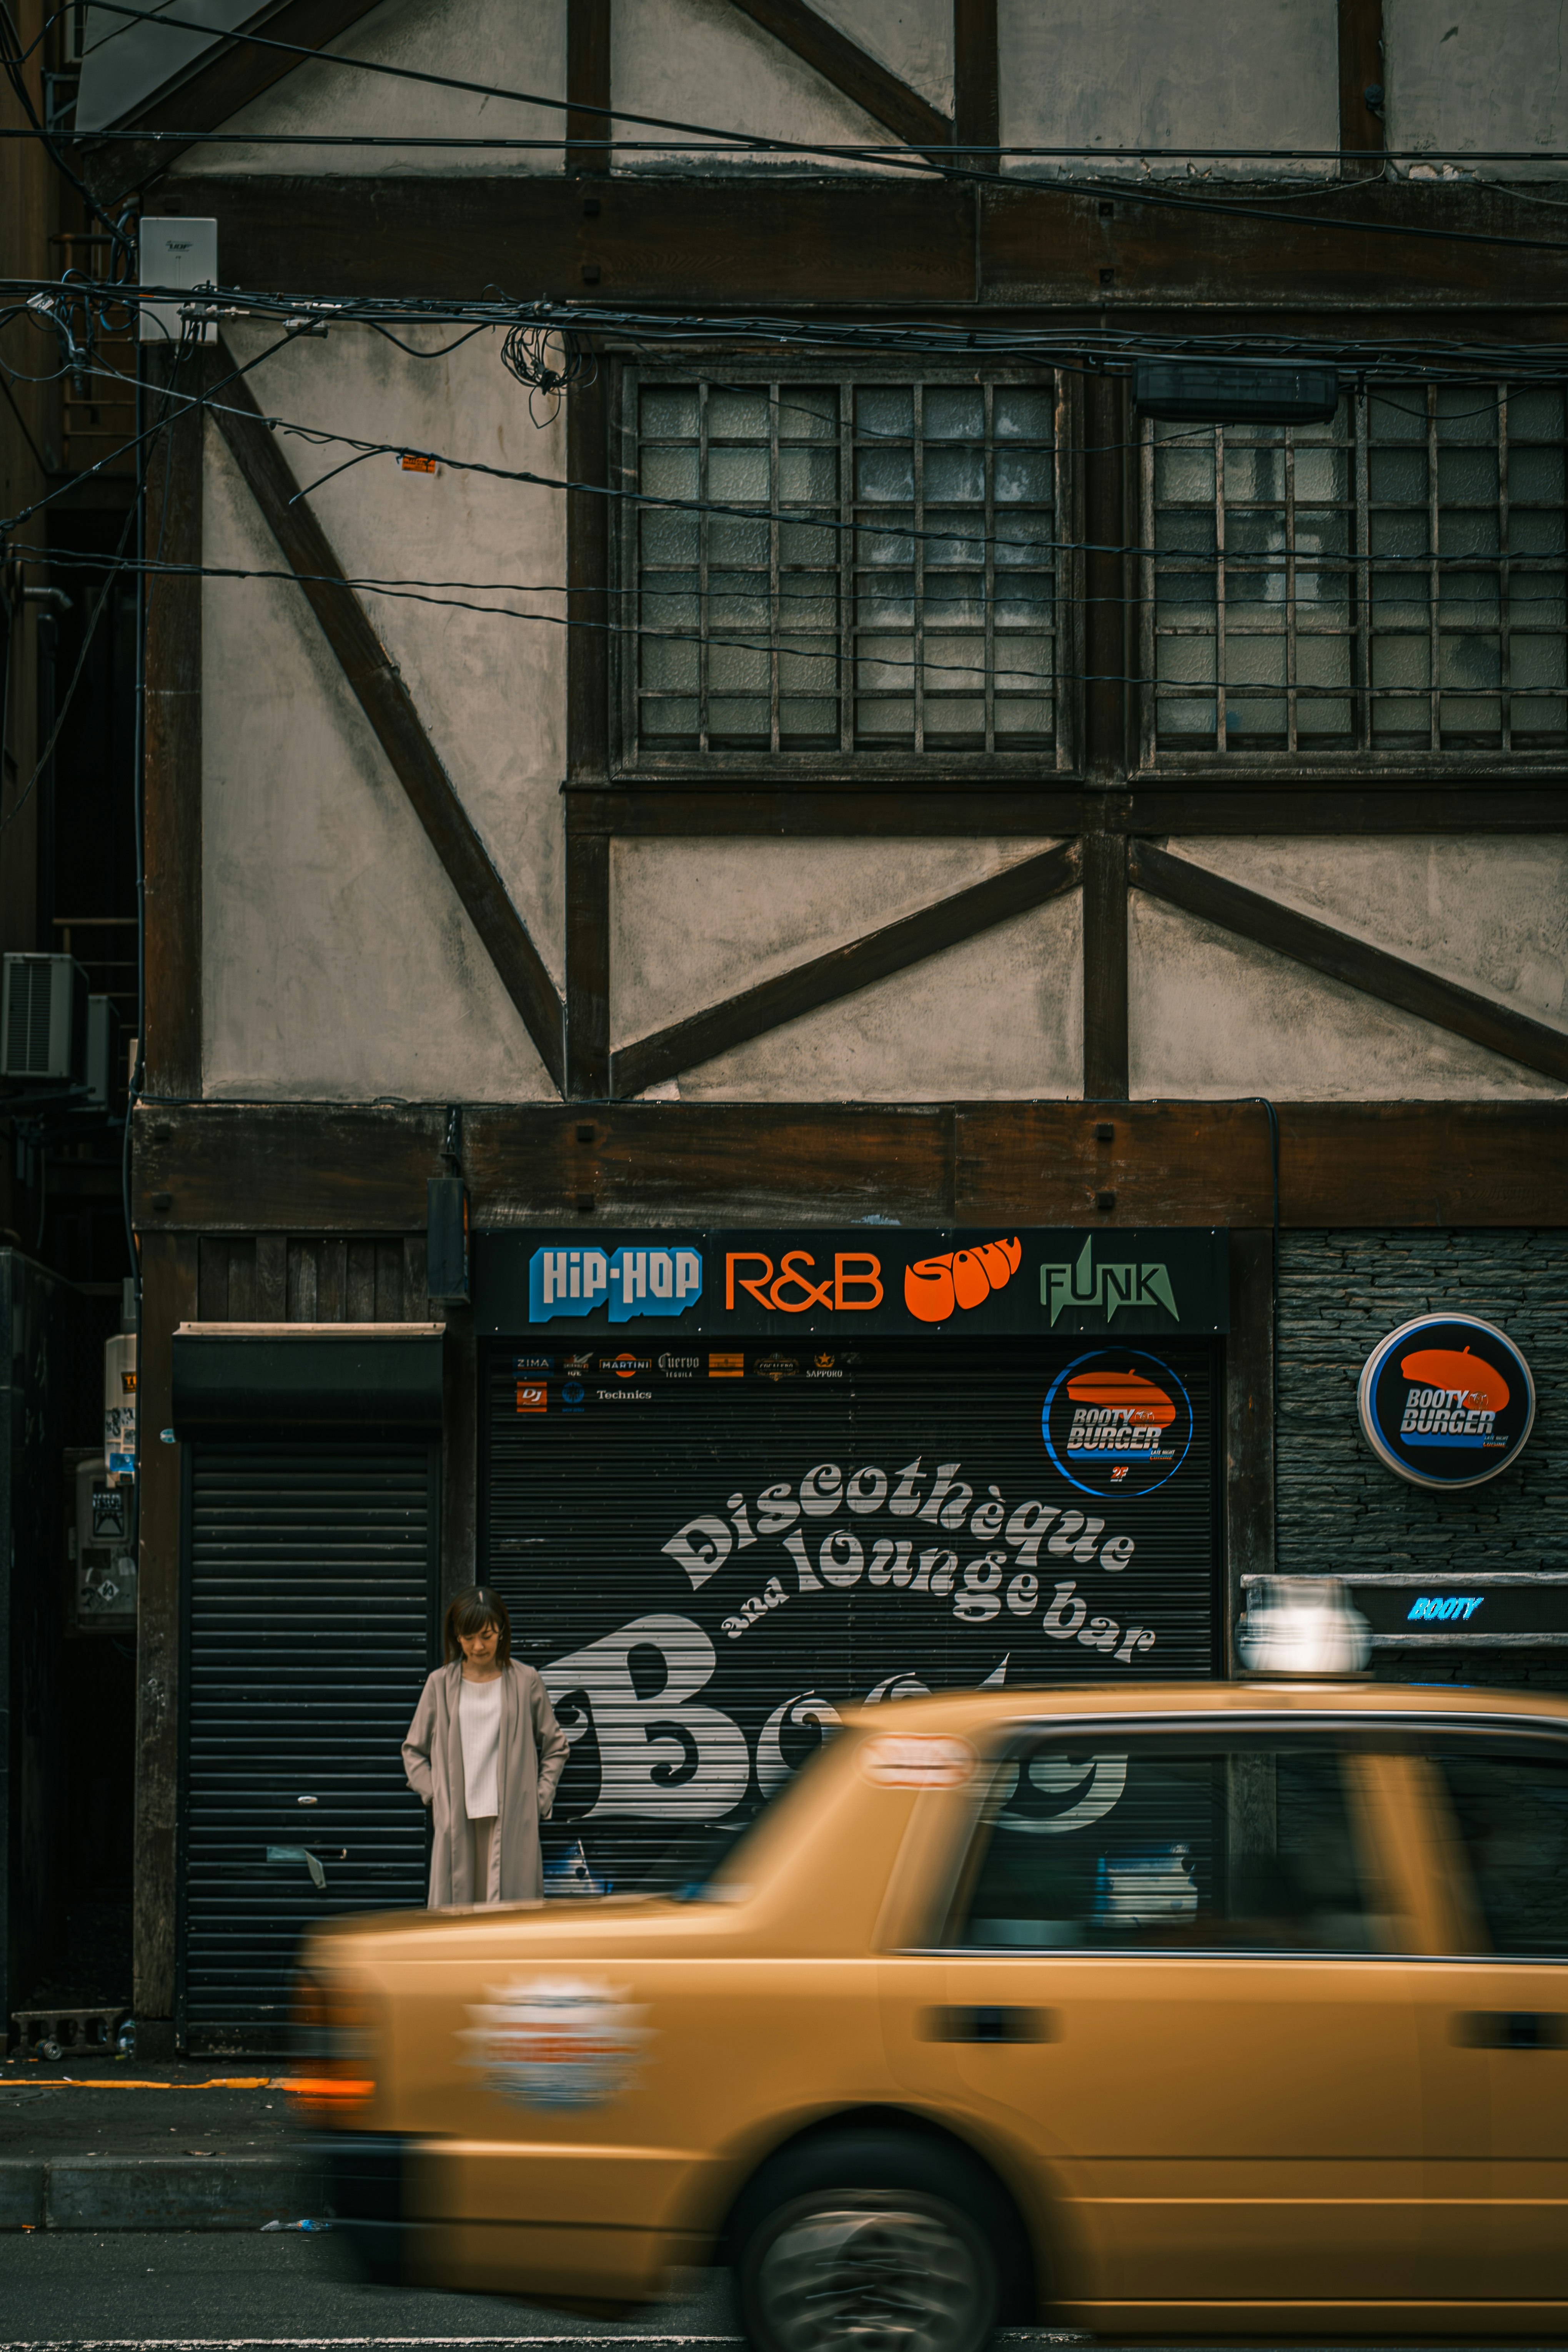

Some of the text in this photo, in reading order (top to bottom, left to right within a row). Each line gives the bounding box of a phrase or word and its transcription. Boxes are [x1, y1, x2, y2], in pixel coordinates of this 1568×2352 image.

[725, 1250, 884, 1312] R&B
[904, 1236, 1022, 1322] SOUL
[1040, 1234, 1180, 1327] FUNK
[518, 1359, 549, 1367] ZIMA
[658, 1352, 699, 1372] Cuervo
[806, 1370, 843, 1378] SAPPORO
[597, 1390, 652, 1399] Technics
[1406, 1388, 1470, 1409] BOOTY
[1072, 1408, 1136, 1427] BOOTY
[1400, 1409, 1496, 1434] BURGER
[1067, 1427, 1162, 1450] BURGER
[1110, 1466, 1129, 1482] 2F
[661, 1456, 1135, 1591] Discothèque
[721, 1528, 1156, 1663] and lounge bar
[1407, 1597, 1485, 1621] BOOTY
